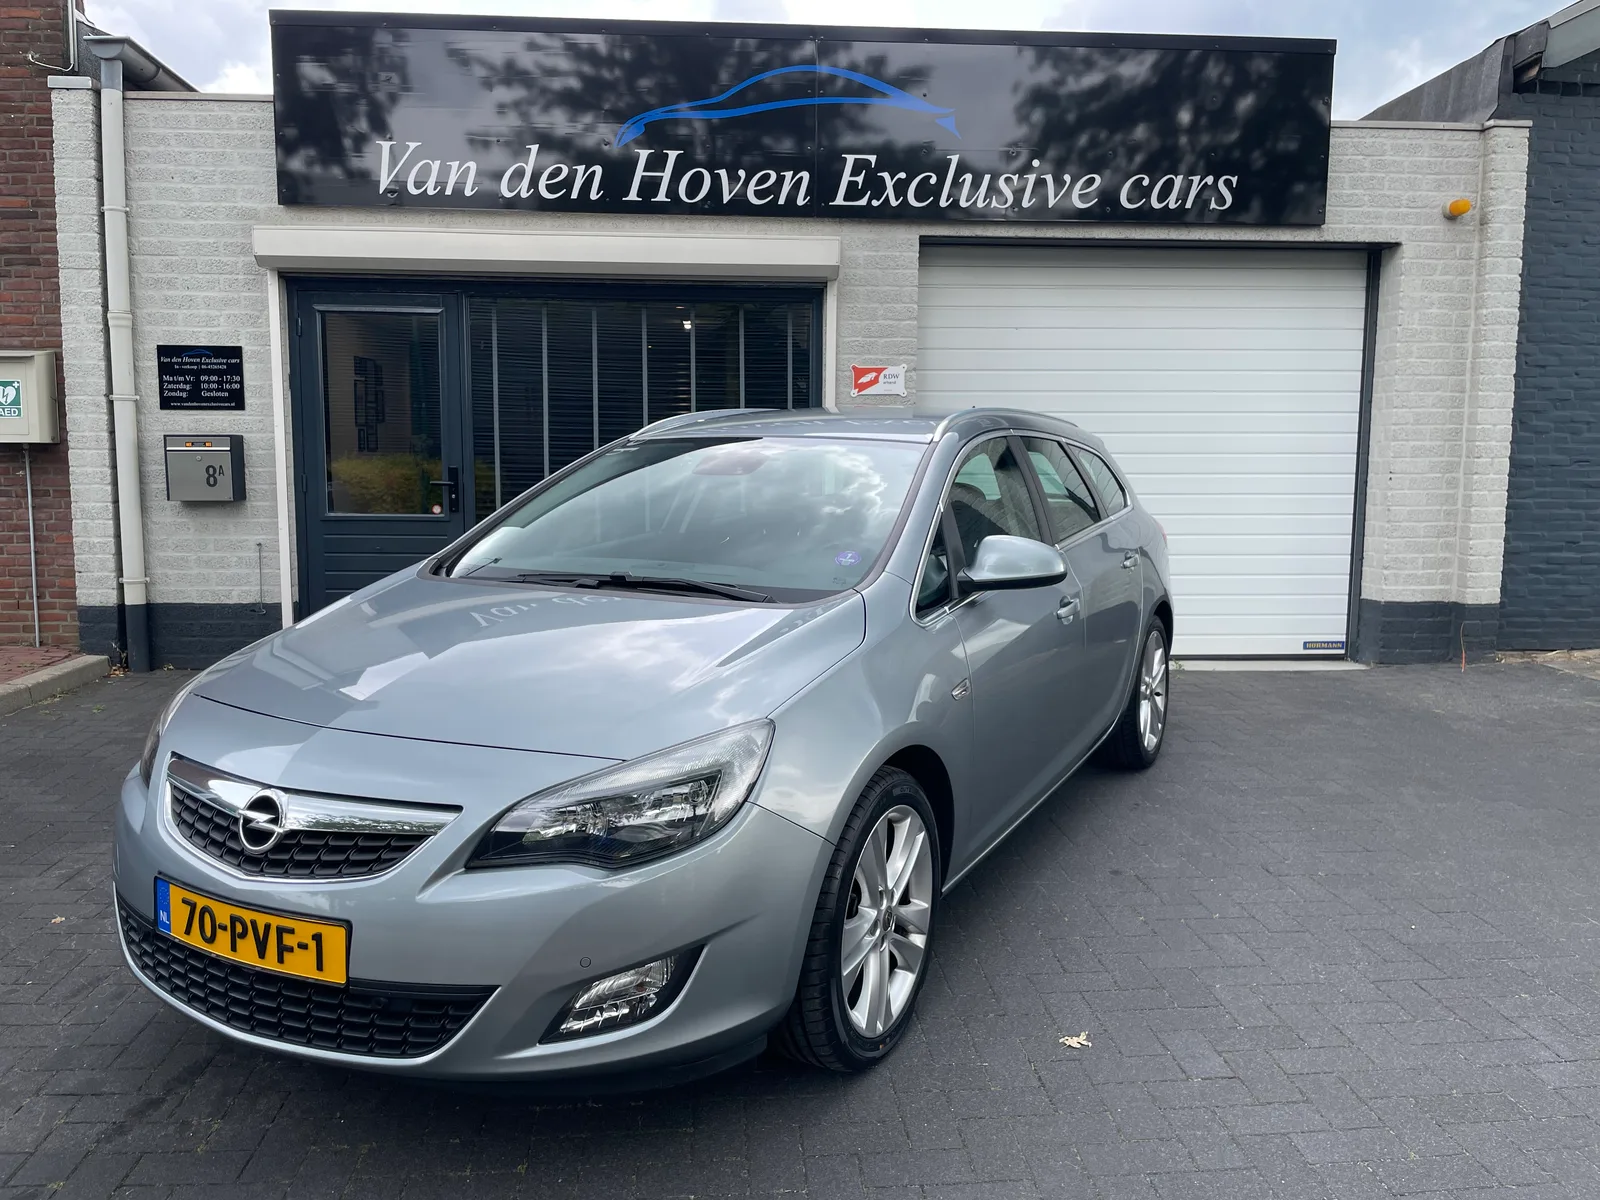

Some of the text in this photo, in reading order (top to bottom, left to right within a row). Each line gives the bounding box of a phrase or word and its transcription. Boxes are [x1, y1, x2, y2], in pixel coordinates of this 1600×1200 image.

[375, 139, 1239, 212] Van den Hoven Exclusive cars
[0, 408, 18, 416] AED
[160, 909, 170, 924] NL
[182, 897, 323, 972] 70-PVF-1
